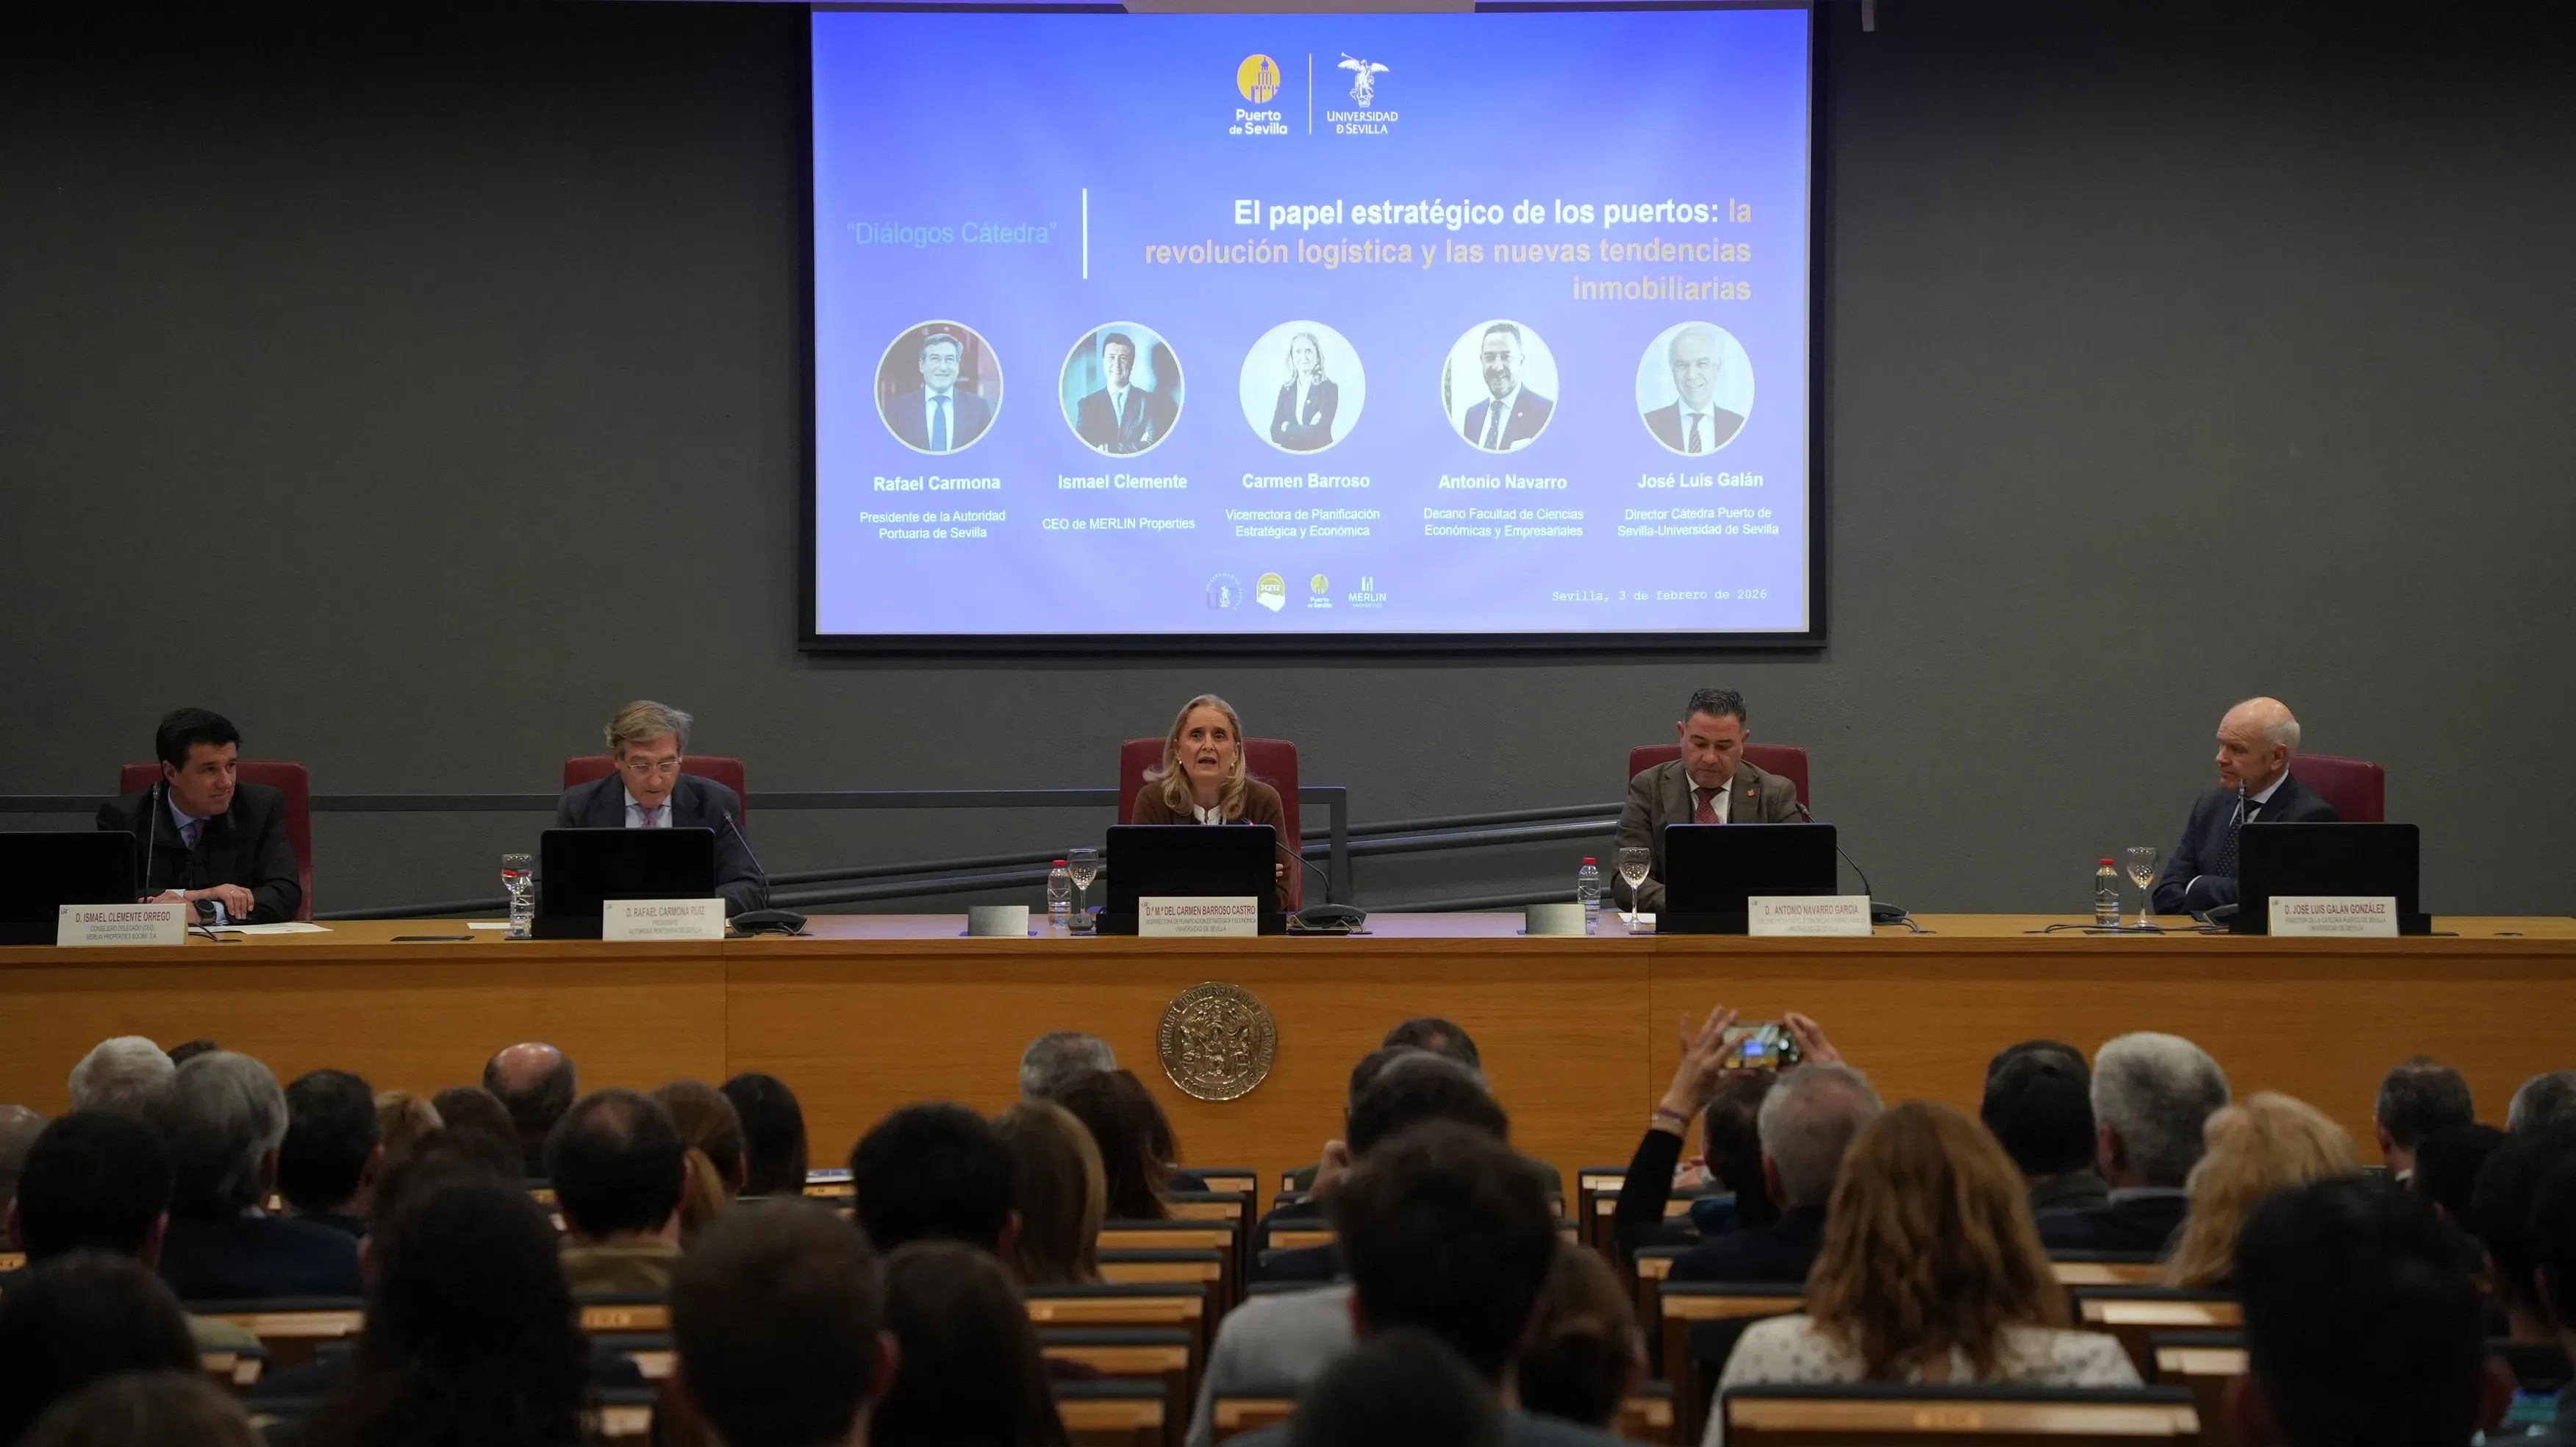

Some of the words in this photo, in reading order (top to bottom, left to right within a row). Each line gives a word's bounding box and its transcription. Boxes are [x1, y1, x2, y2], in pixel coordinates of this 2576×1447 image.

[1236, 108, 1281, 121] Puerto
[1327, 110, 1398, 122] UNIVERSIDAD
[1229, 124, 1243, 135] de
[1245, 123, 1288, 135] Sevilla
[1345, 123, 1388, 135] SEVILLA
[1234, 199, 1260, 225] El
[1270, 199, 1343, 231] papel
[1351, 198, 1504, 231] estratégico
[1512, 199, 1545, 224] de
[1555, 199, 1595, 224] los
[1604, 198, 1718, 229] puertos:
[1729, 198, 1752, 223] la
[847, 221, 955, 249] “Diálogos
[962, 221, 1057, 244] Cátedra”
[1145, 238, 1289, 265] revolución
[1298, 237, 1412, 270] logística
[1421, 244, 1437, 270] y
[1446, 237, 1484, 263] las
[1494, 243, 1591, 263] nuevas
[1599, 237, 1751, 262] tendencias
[1574, 275, 1751, 301] inmobiliarias
[873, 476, 923, 491] Rafael
[928, 475, 1001, 491] Carmona
[1058, 474, 1109, 489] Ismael
[1114, 474, 1187, 489] Clemente
[1242, 473, 1303, 489] Carmen
[1307, 473, 1370, 488] Barroso
[1437, 474, 1501, 489] Antonio
[1505, 474, 1567, 490] Navarro
[1637, 472, 1676, 489] José
[1679, 472, 1714, 488] Luis
[1717, 471, 1764, 487] Galán
[859, 511, 920, 523] Presidente
[922, 511, 937, 523] de
[940, 511, 951, 522] la
[952, 510, 1006, 522] Autoridad
[1225, 509, 1292, 521] Vicerrectora
[1294, 508, 1309, 521] de
[1312, 508, 1380, 520] Planificación
[1423, 507, 1467, 519] Decano
[1469, 507, 1517, 520] Facultad
[1519, 508, 1534, 520] de
[1536, 508, 1584, 520] Ciencias
[1625, 509, 1670, 521] Director
[1670, 507, 1714, 520] Cátedra
[1718, 507, 1755, 518] Puerto
[1757, 507, 1772, 518] de
[1042, 518, 1070, 530] CEO
[1072, 518, 1087, 530] de
[1089, 517, 1136, 529] MERLIN
[1139, 517, 1195, 531] Properties
[1617, 524, 1722, 536] Sevilla-Universidad
[1725, 524, 1739, 535] de
[1742, 523, 1779, 535] Sevilla
[879, 527, 930, 539] Portuaria
[932, 527, 948, 539] de
[950, 526, 987, 538] Sevilla
[1236, 525, 1297, 540] Estratégica
[1299, 527, 1307, 540] y
[1309, 525, 1370, 537] Económica
[1424, 524, 1492, 537] Económicas
[1494, 527, 1501, 540] y
[1504, 525, 1584, 539] Empresariales
[1348, 593, 1387, 602] MERLIN
[1552, 590, 1609, 602] Sevilla,
[1618, 590, 1626, 601] 3
[1633, 590, 1649, 601] de
[1656, 590, 1708, 601] febrero
[1714, 589, 1730, 599] de
[1737, 588, 1767, 599] 2026
[626, 908, 631, 917] D.
[634, 907, 657, 917] RAFAEL
[659, 907, 689, 916] CARMONA
[690, 906, 705, 915] RUIZ
[1164, 907, 1176, 915] DEL
[1176, 906, 1201, 915] CARMEN
[1202, 906, 1231, 915] BARROSO
[1232, 906, 1256, 915] CASTRO
[1765, 906, 1771, 915] D.
[1775, 906, 1802, 915] ANTONIO
[1803, 906, 1833, 915] NAVARRO
[1835, 904, 1858, 915] GARCÍA
[2285, 905, 2291, 914] D.
[2293, 903, 2309, 914] JOSÉ
[2311, 905, 2325, 914] LUIS
[2326, 903, 2349, 914] GALÁN
[2350, 903, 2385, 914] GONZÁLEZ
[76, 913, 82, 923] D.
[83, 912, 107, 922] ISMAEL
[108, 912, 142, 922] CLEMENTE
[143, 912, 171, 921] ORREGO
